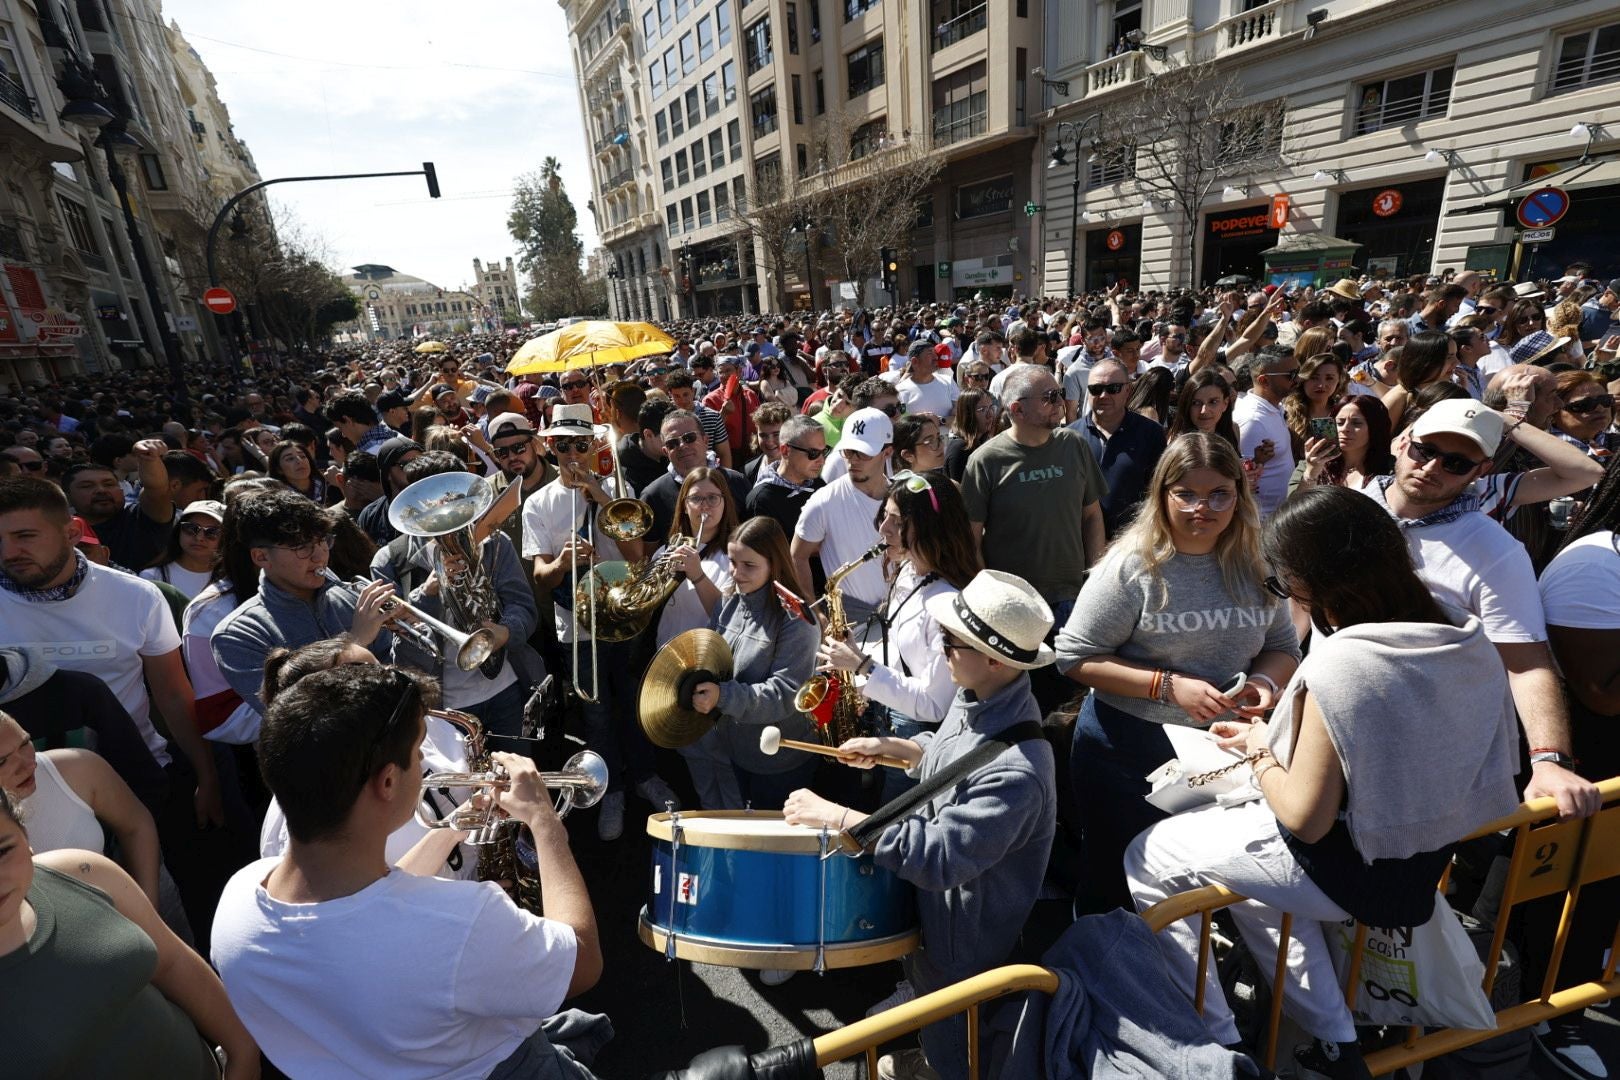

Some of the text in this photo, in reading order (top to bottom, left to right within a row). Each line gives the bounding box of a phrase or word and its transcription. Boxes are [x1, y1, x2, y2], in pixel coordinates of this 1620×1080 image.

[1464, 409, 1476, 419] C
[851, 419, 866, 436] NY
[42, 645, 110, 656] POLO
[1529, 842, 1559, 878] 2
[1367, 937, 1406, 959] cash
